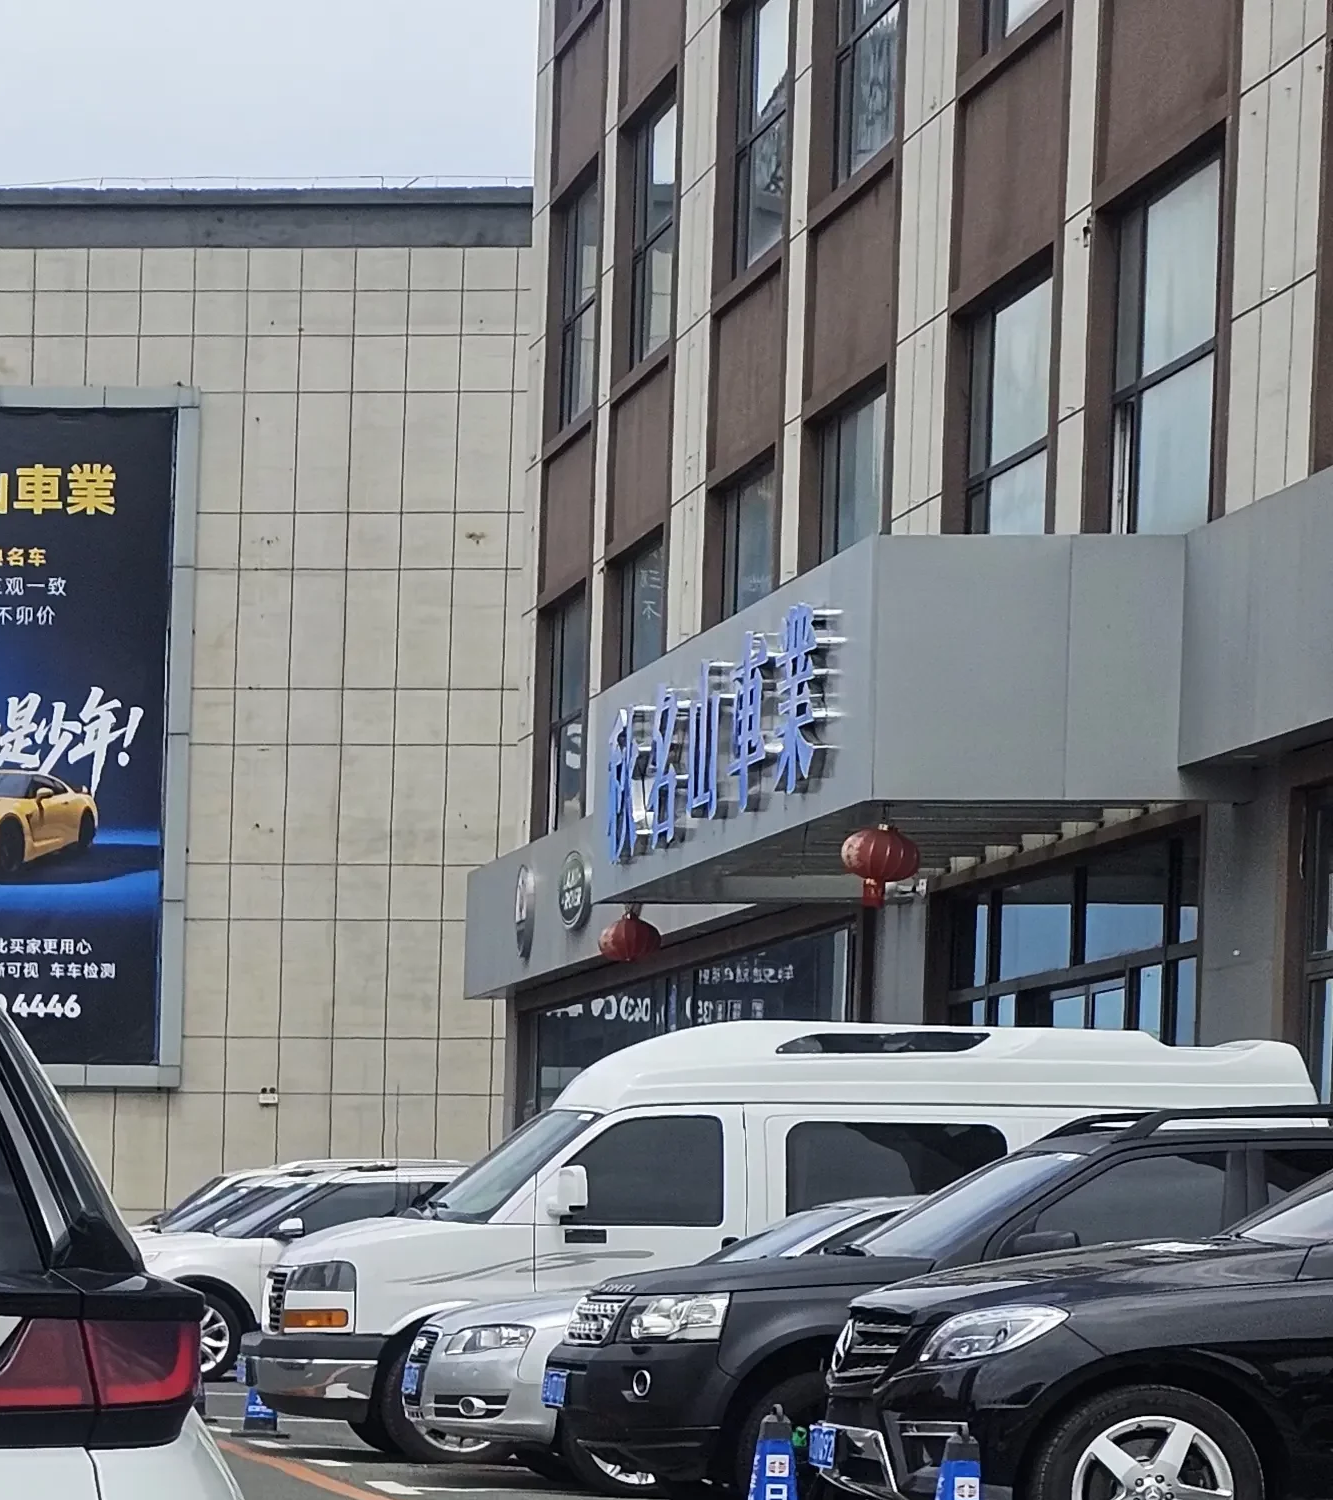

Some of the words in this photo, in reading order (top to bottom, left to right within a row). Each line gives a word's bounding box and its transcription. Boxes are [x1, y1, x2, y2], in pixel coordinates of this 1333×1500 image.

[607, 602, 818, 865] 秋名山車業
